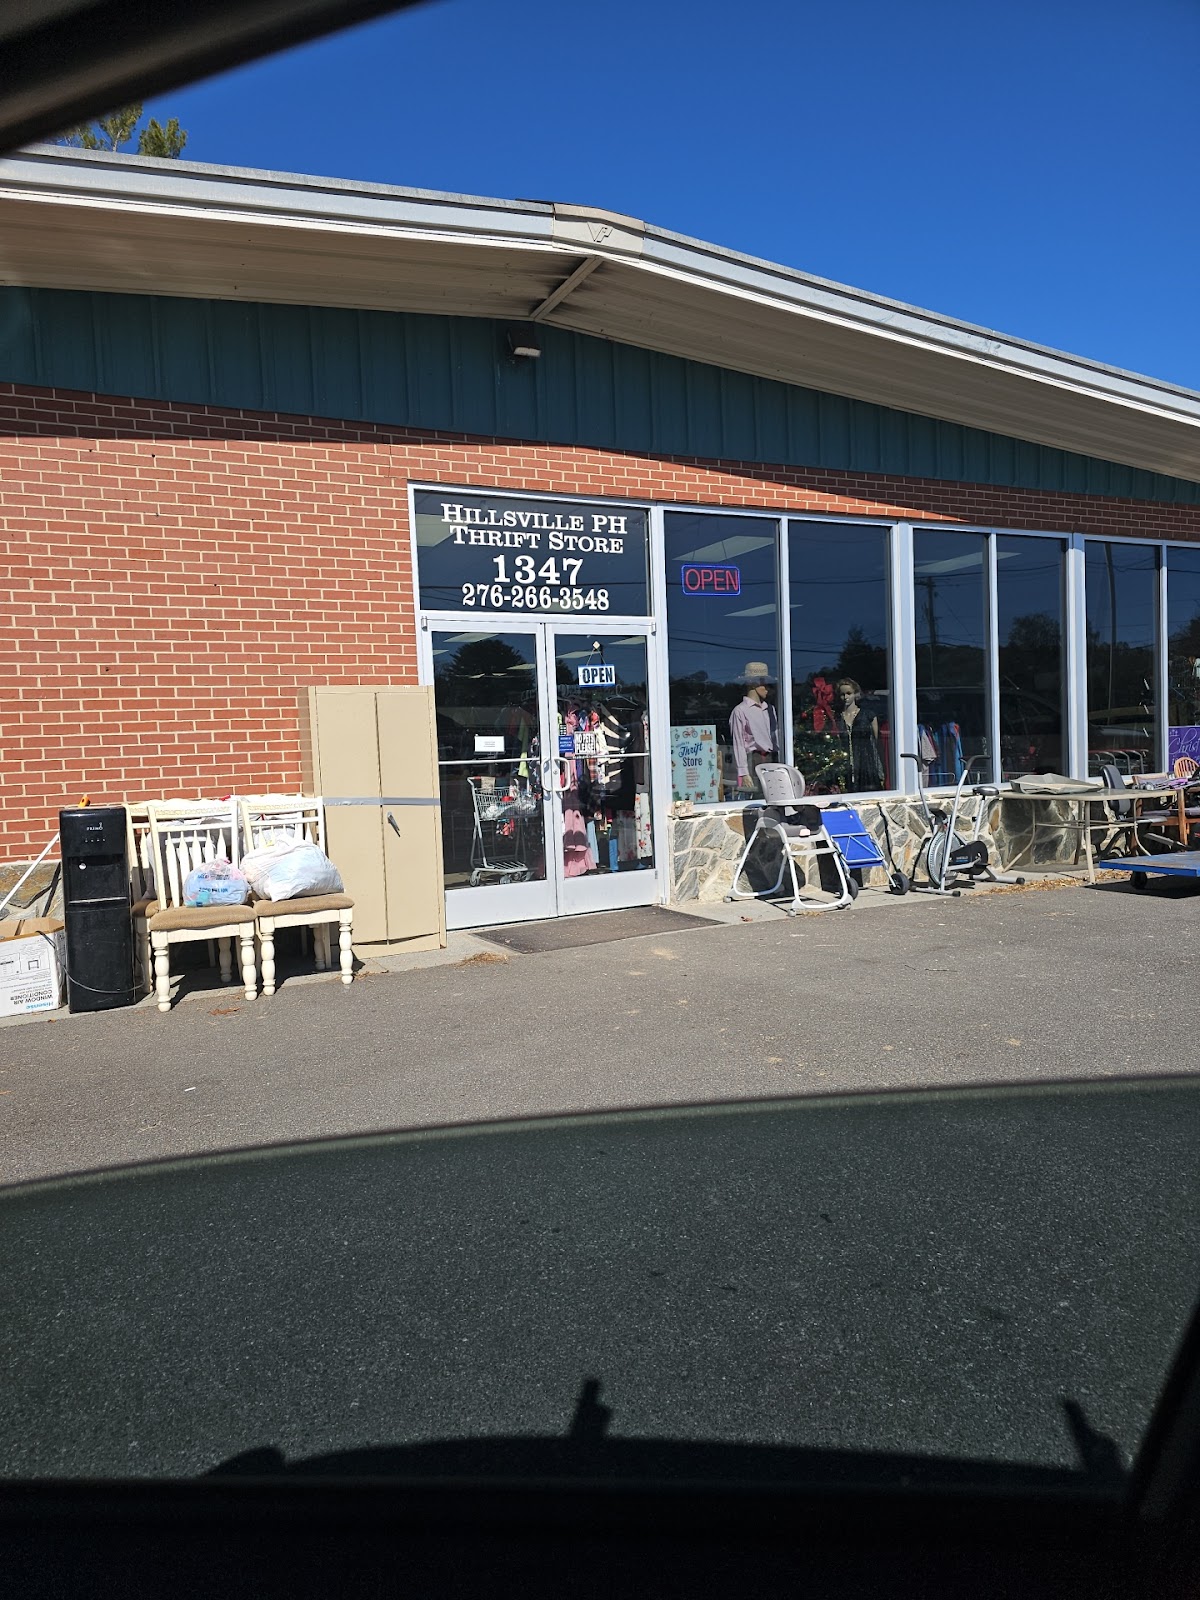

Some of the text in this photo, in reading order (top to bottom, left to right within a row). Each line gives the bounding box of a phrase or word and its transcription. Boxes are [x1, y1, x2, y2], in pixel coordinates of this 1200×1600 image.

[440, 503, 628, 534] HILLSVILLE PH
[449, 525, 624, 554] THRIFT STORE
[492, 554, 584, 586] 1347
[685, 568, 739, 591] OPEN
[462, 583, 610, 611] 276-266-3548
[582, 667, 613, 685] OPEN
[678, 742, 703, 758] Thrift
[682, 757, 703, 767] Store
[10, 990, 53, 1001] CONDITIONER
[25, 995, 53, 1003] WINDOW
